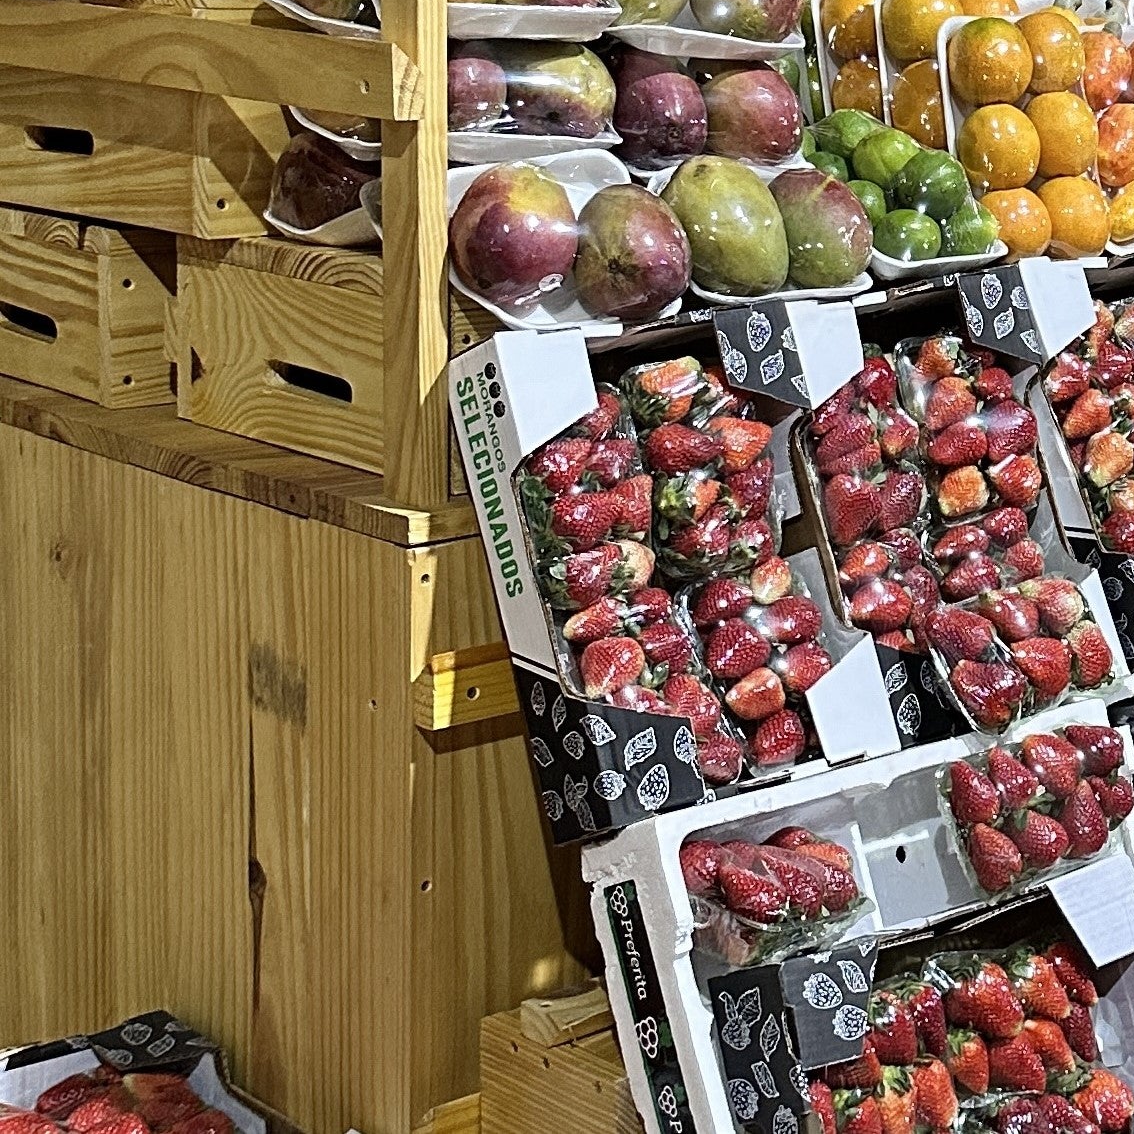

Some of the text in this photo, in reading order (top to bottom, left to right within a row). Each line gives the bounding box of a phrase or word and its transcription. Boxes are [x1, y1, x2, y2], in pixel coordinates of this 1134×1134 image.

[476, 371, 506, 473] MORANGOS
[456, 376, 524, 599] SELECIONADOS
[621, 919, 647, 1000] Preferita
